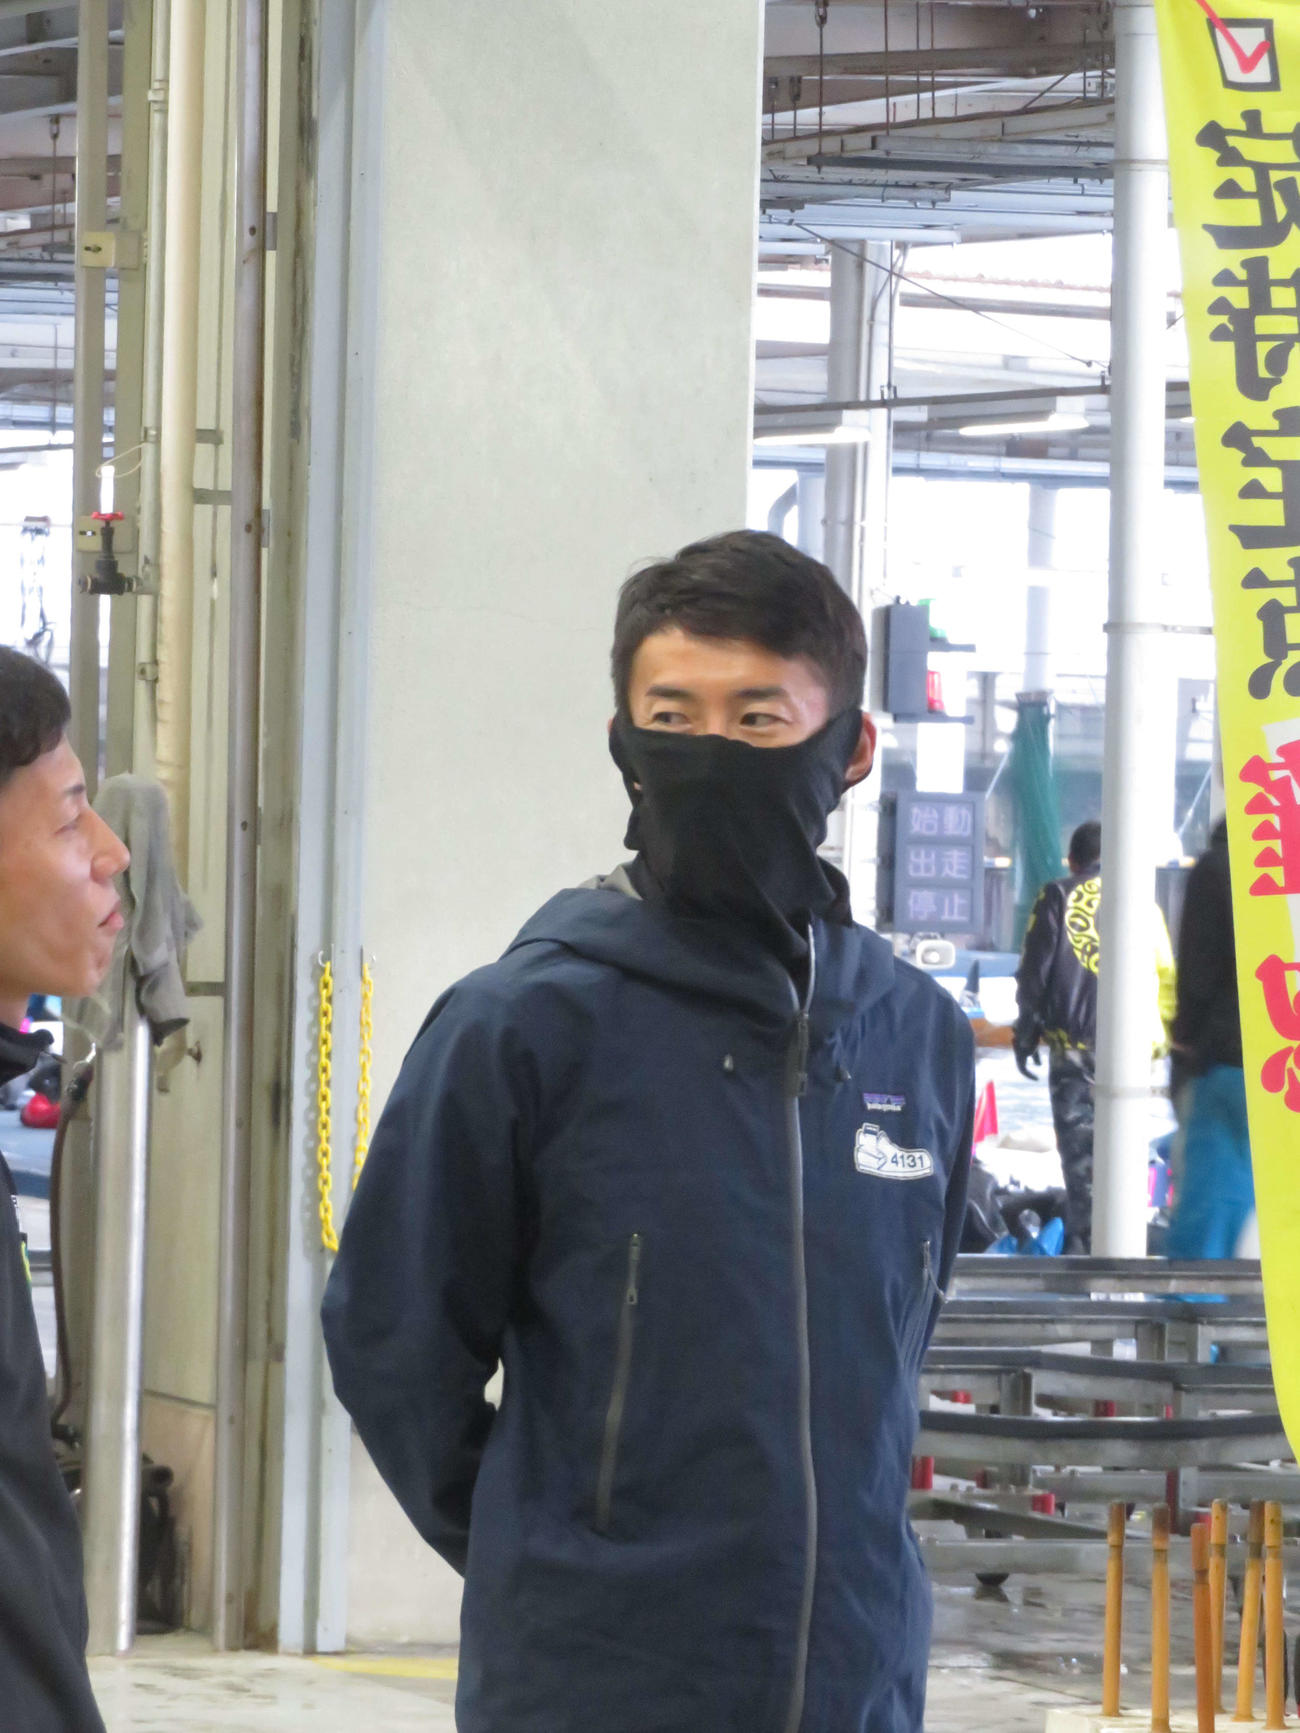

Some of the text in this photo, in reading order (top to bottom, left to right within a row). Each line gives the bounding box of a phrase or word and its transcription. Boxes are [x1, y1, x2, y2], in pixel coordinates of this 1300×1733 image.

[909, 804, 972, 837] 始動
[908, 848, 970, 880] 出走
[907, 889, 970, 922] 停止
[890, 1153, 925, 1169] 4131
